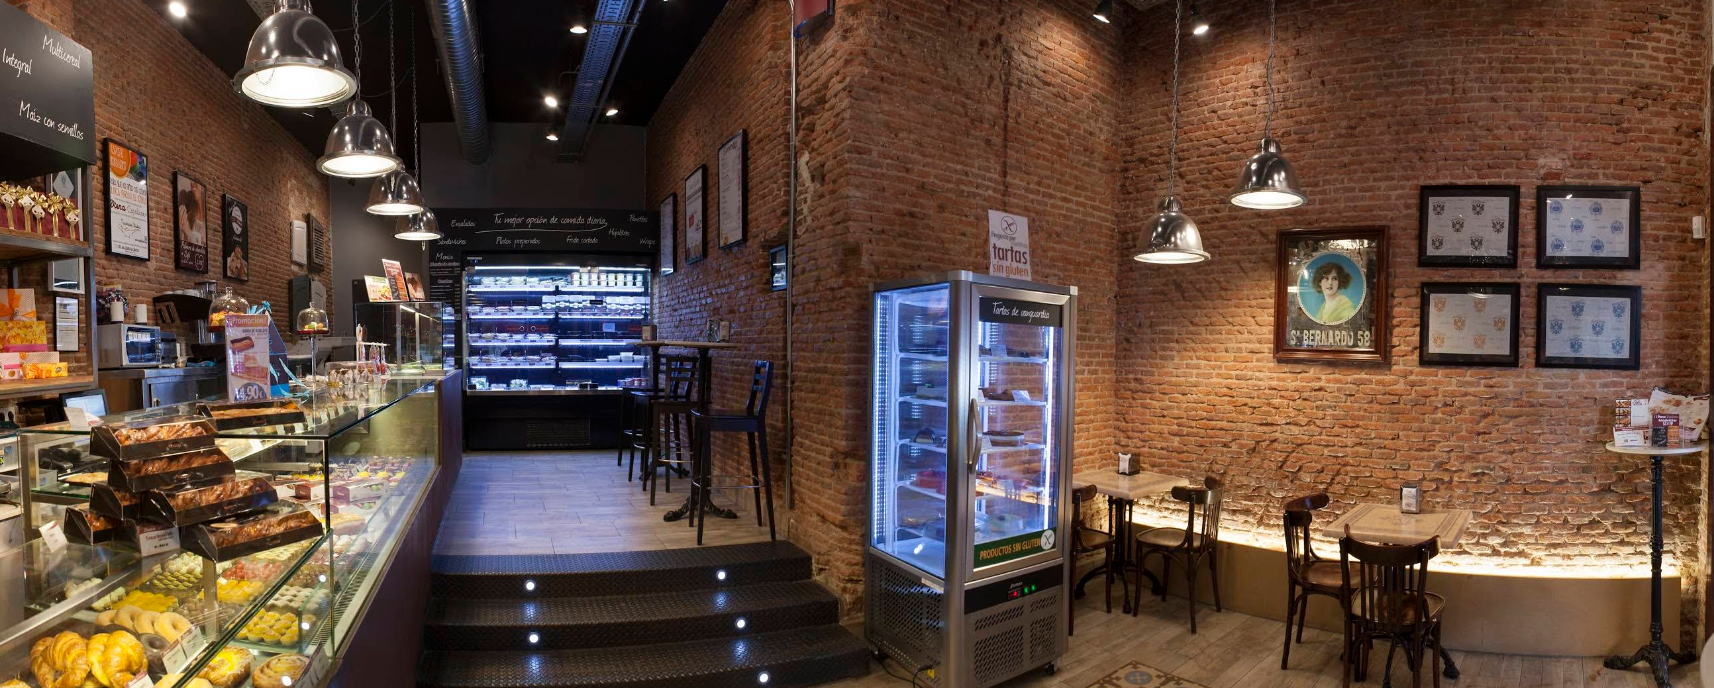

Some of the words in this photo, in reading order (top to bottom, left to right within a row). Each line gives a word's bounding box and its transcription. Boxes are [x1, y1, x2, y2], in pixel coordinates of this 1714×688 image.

[42, 34, 80, 69] Multicereal
[2, 48, 33, 77] Integral
[43, 116, 56, 130] con
[493, 212, 505, 224] Tu
[504, 215, 524, 228] mejor
[525, 215, 548, 228] opción
[549, 215, 558, 224] de
[560, 216, 585, 224] comida
[586, 215, 606, 225] diaria
[992, 243, 1028, 265] tartas
[992, 263, 1004, 273] sin
[1005, 263, 1029, 277] gluten
[992, 301, 1010, 316] Tartas
[1011, 306, 1019, 316] de
[1303, 329, 1354, 346] BERNARDO
[1357, 331, 1371, 347] 58
[980, 546, 1012, 559] PRODUCTOS
[1012, 542, 1021, 553] SIN
[1021, 539, 1040, 550] GLUTEN
